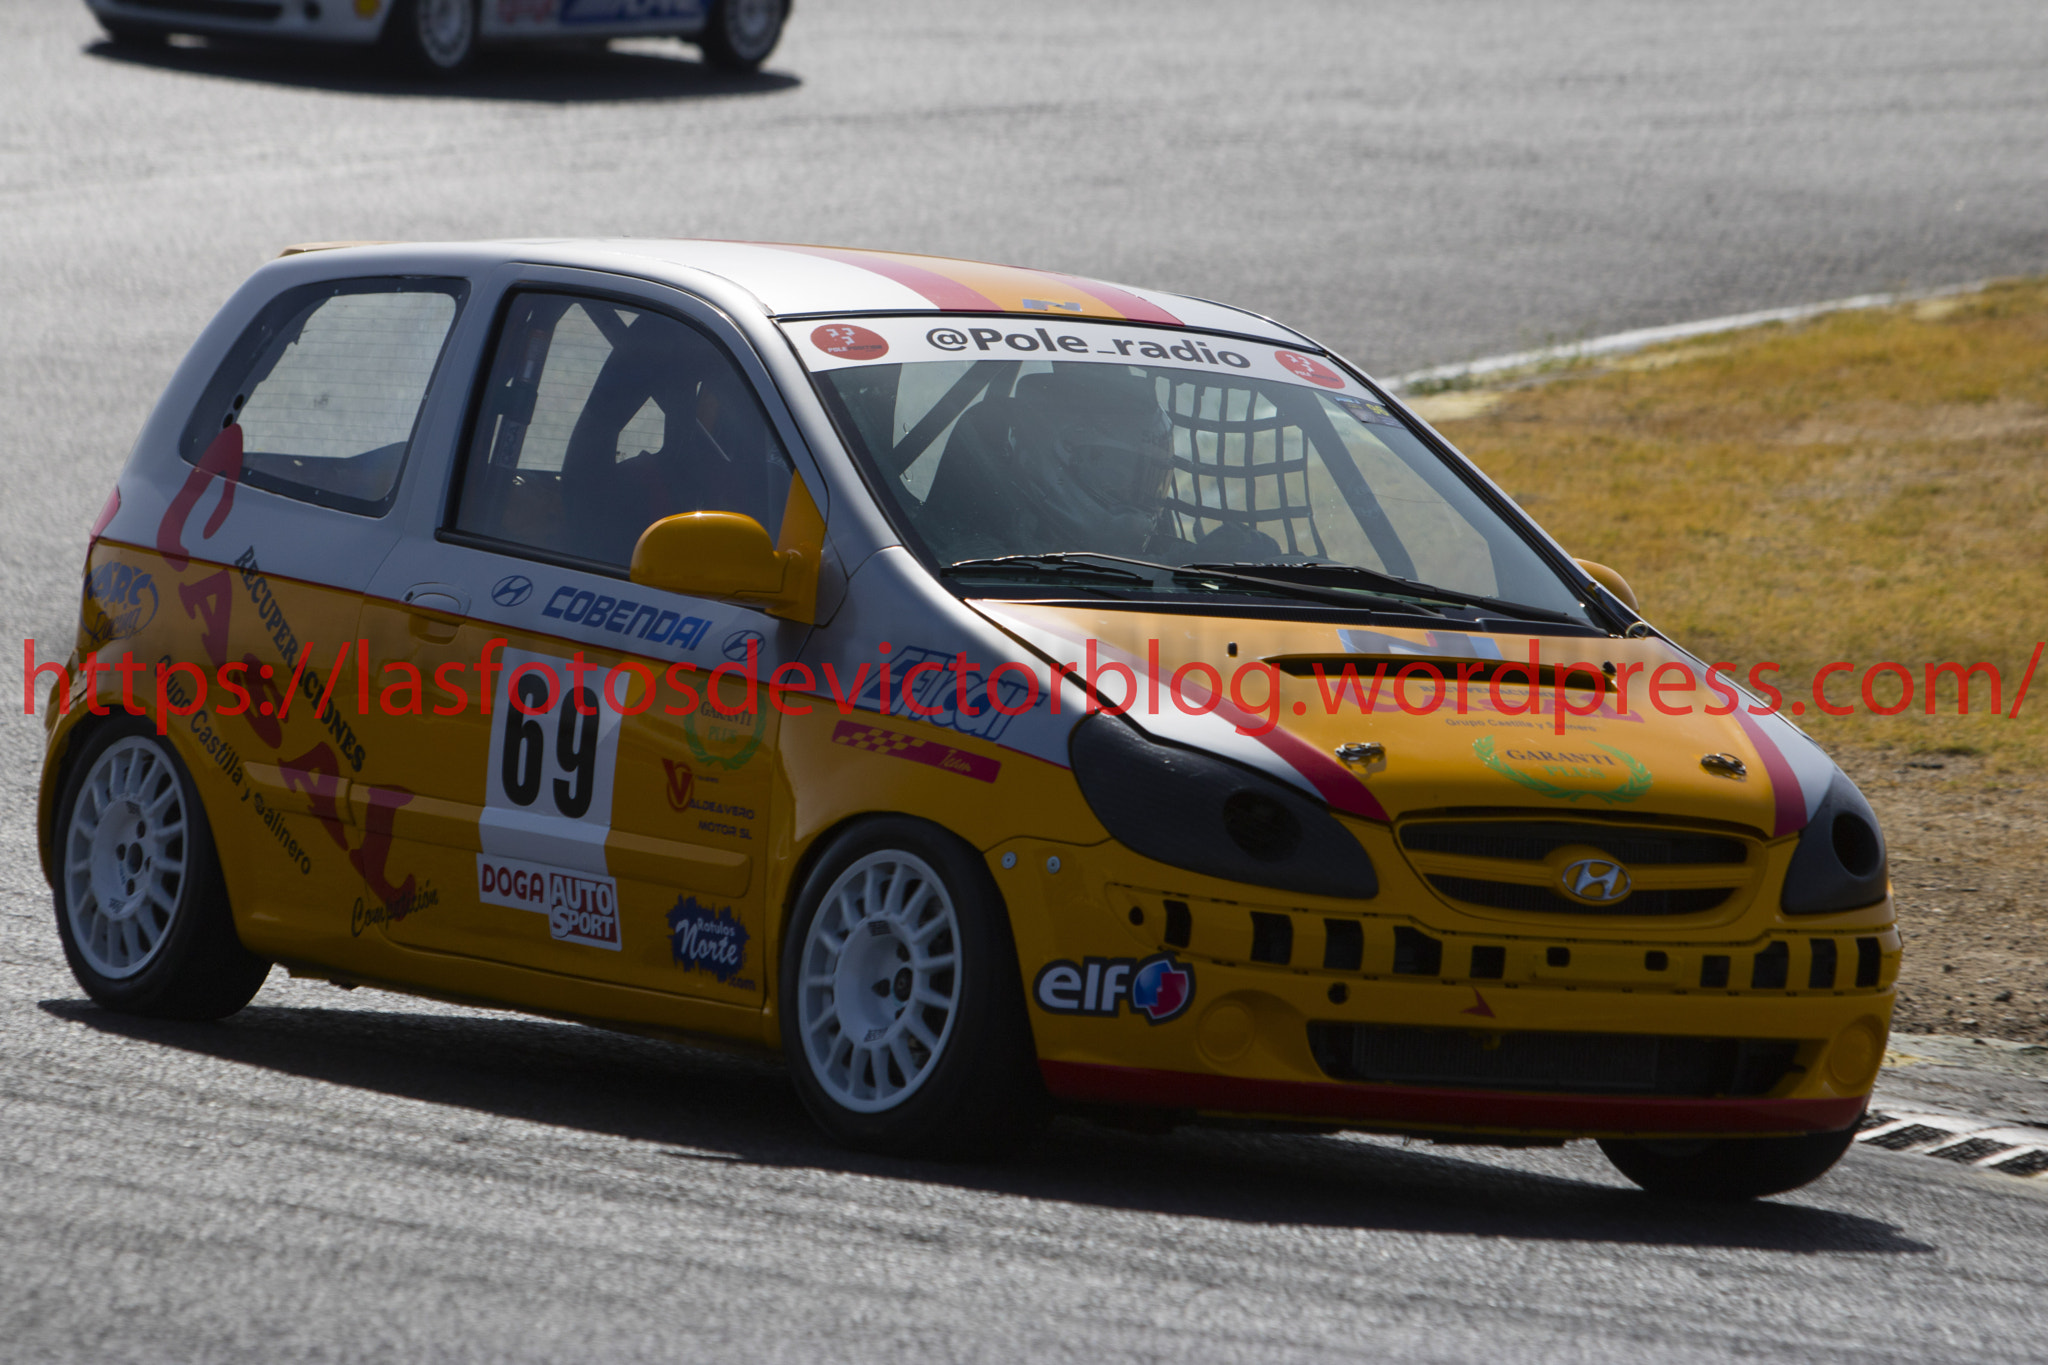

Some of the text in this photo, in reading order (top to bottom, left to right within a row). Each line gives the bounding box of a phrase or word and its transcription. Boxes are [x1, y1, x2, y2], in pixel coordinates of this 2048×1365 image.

[925, 327, 1251, 369] @Pole_radio
[541, 586, 713, 651] COBENDAI
[502, 673, 600, 818] 69
[1506, 749, 1615, 766] GARANTI
[190, 710, 244, 785] Castilla
[254, 792, 311, 875] Salinero
[698, 821, 737, 836] MOTOR
[482, 863, 544, 903] DOGA
[550, 874, 613, 916] AUTO
[552, 905, 615, 939] SPORT
[675, 919, 739, 965] Norte
[1038, 963, 1131, 1012] elf
